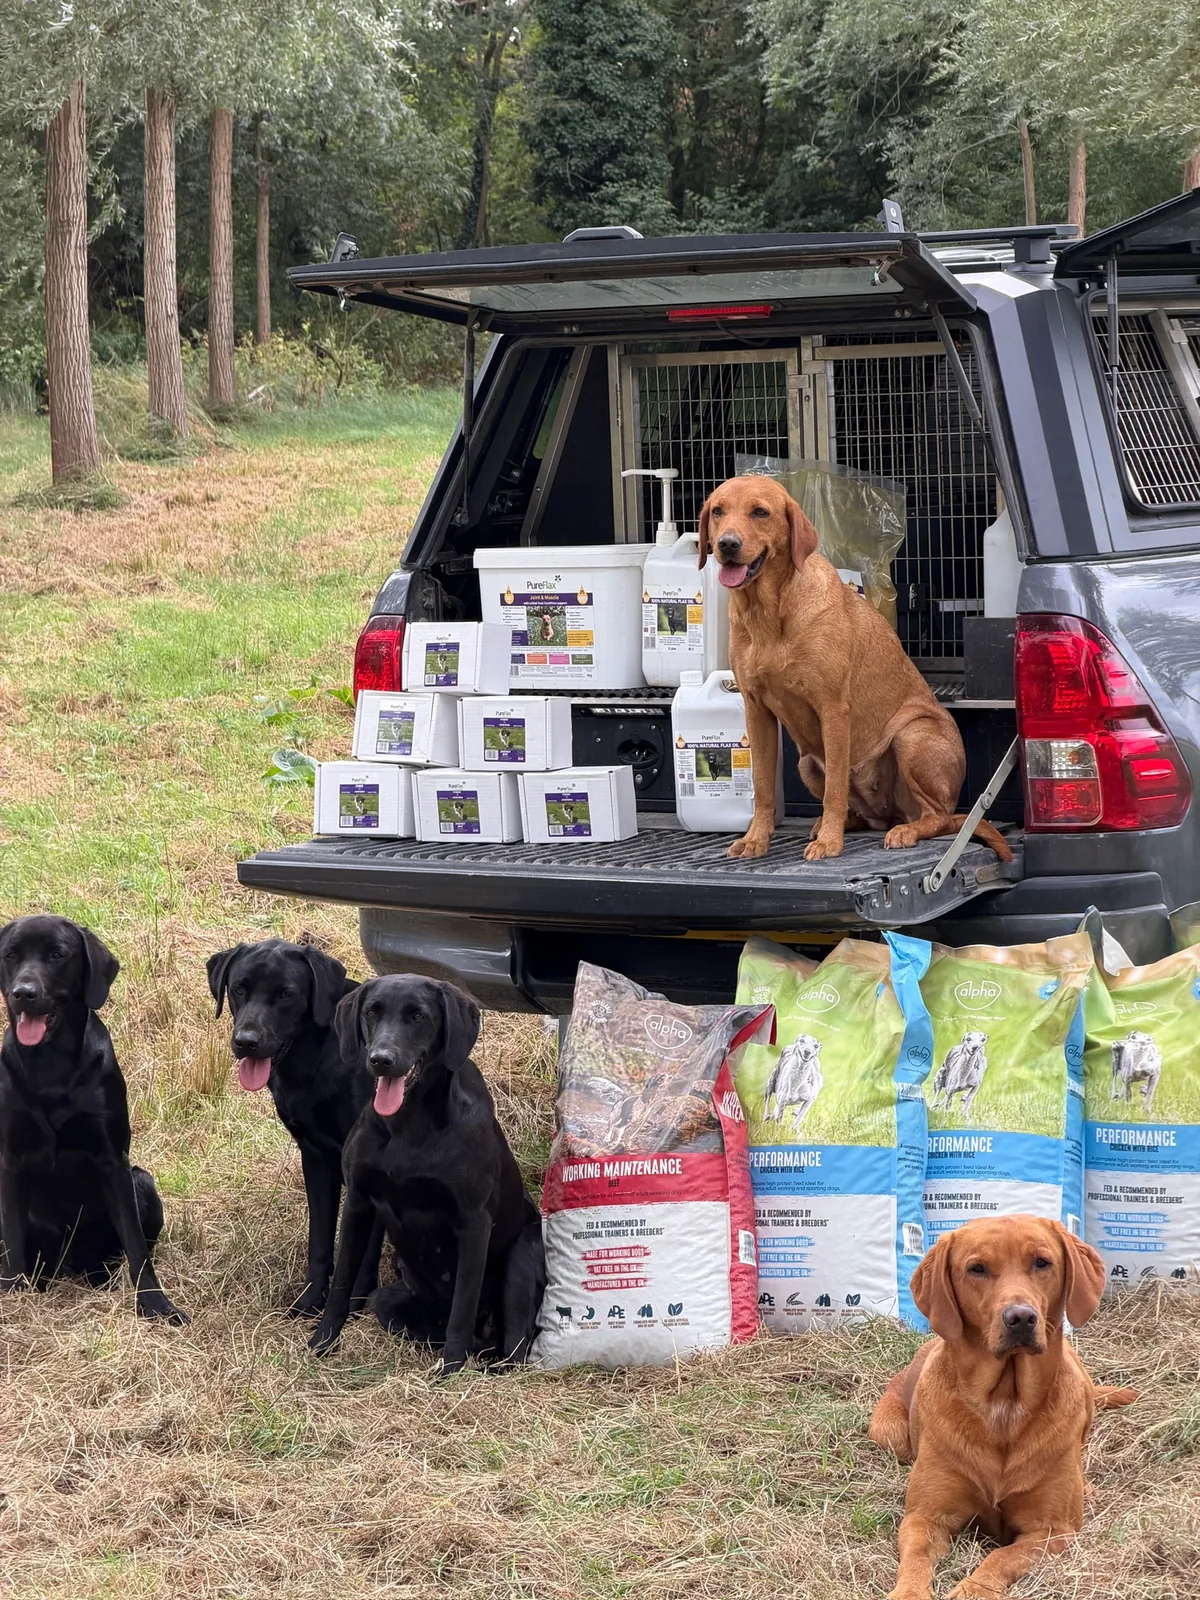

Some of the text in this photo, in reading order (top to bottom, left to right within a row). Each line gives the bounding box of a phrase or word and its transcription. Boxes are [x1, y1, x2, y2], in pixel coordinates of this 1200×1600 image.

[526, 580, 556, 590] PureFlax
[801, 986, 835, 1003] alpha
[960, 982, 996, 1000] alpha
[649, 1017, 688, 1040] alpha
[1096, 1128, 1176, 1146] PERFORMANCE
[1110, 1144, 1159, 1153] CHICKEN WITH RICE
[749, 1151, 821, 1168] PERFORMANCE
[562, 1158, 682, 1182] WORKING MAINTENANCE
[608, 1178, 620, 1187] BEEF
[1104, 1185, 1112, 1193] FED
[1114, 1185, 1118, 1193] &
[1120, 1186, 1158, 1195] RECOMMENDED
[934, 1193, 973, 1201] RECOMMENDED
[1088, 1192, 1122, 1202] PROFESSIONAL
[1123, 1194, 1148, 1203] TRAINERS
[938, 1202, 963, 1210] TRAINERS
[964, 1202, 968, 1210] &
[763, 1209, 811, 1218] & RECOMMENDED BY
[1128, 1214, 1150, 1222] WORKING
[586, 1219, 646, 1230] FED & RECOMMENDED BY
[932, 1221, 940, 1229] FOR
[572, 1231, 603, 1240] PROFESSIONAL
[604, 1229, 628, 1238] TRAINERS
[630, 1228, 634, 1236] &
[1139, 1228, 1148, 1236] THE
[765, 1238, 774, 1246] FOR
[774, 1238, 795, 1246] WORKING
[586, 1250, 598, 1258] MADE
[599, 1250, 608, 1258] FOR
[631, 1249, 644, 1257] DOGS
[602, 1265, 613, 1273] FREE
[587, 1280, 620, 1288] MANUFACTURED
[628, 1279, 636, 1287] THE
